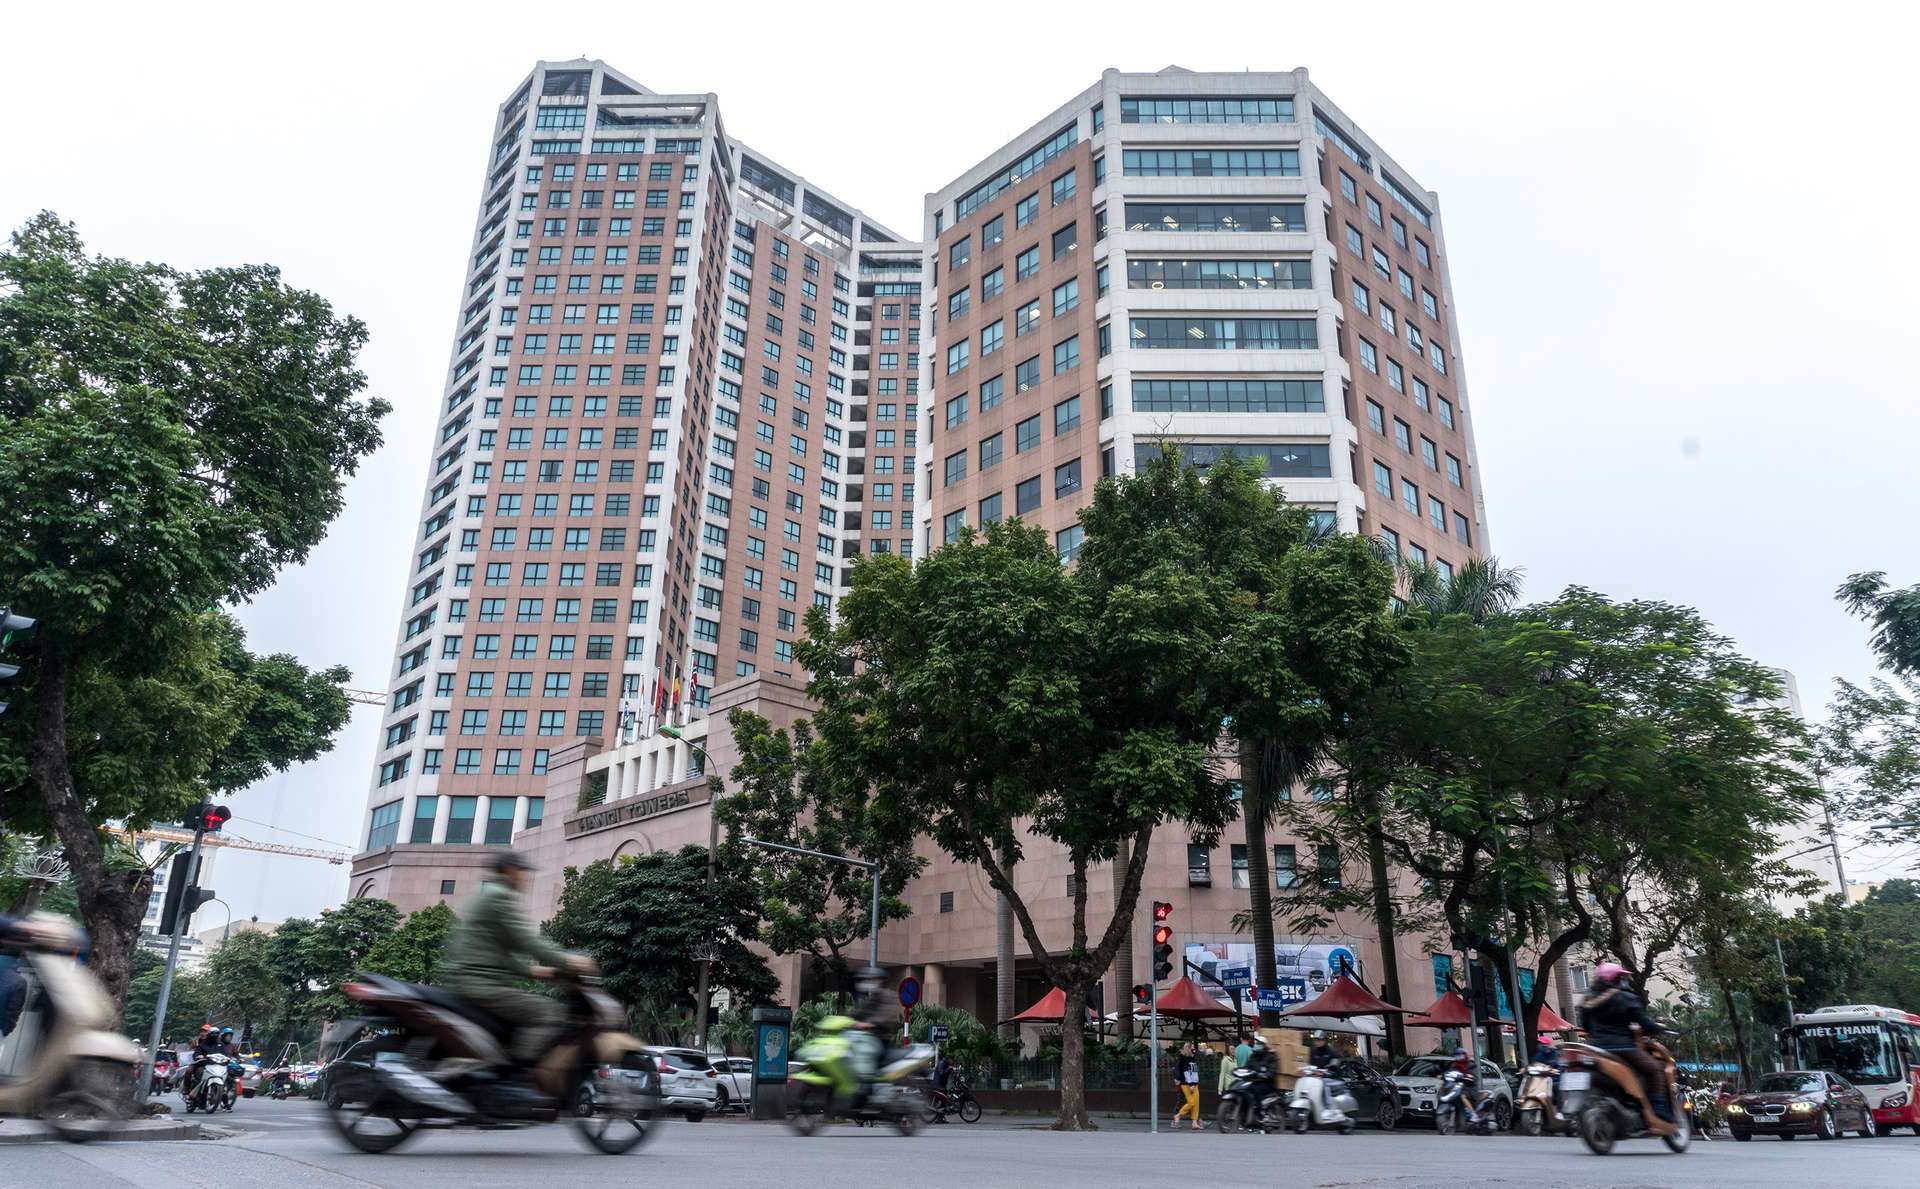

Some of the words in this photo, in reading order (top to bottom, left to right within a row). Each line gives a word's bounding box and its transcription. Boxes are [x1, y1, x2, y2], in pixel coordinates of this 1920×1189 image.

[626, 790, 690, 819] TOWERS
[1804, 1027, 1832, 1037] VIỆT
[1834, 1026, 1881, 1035] THANH
